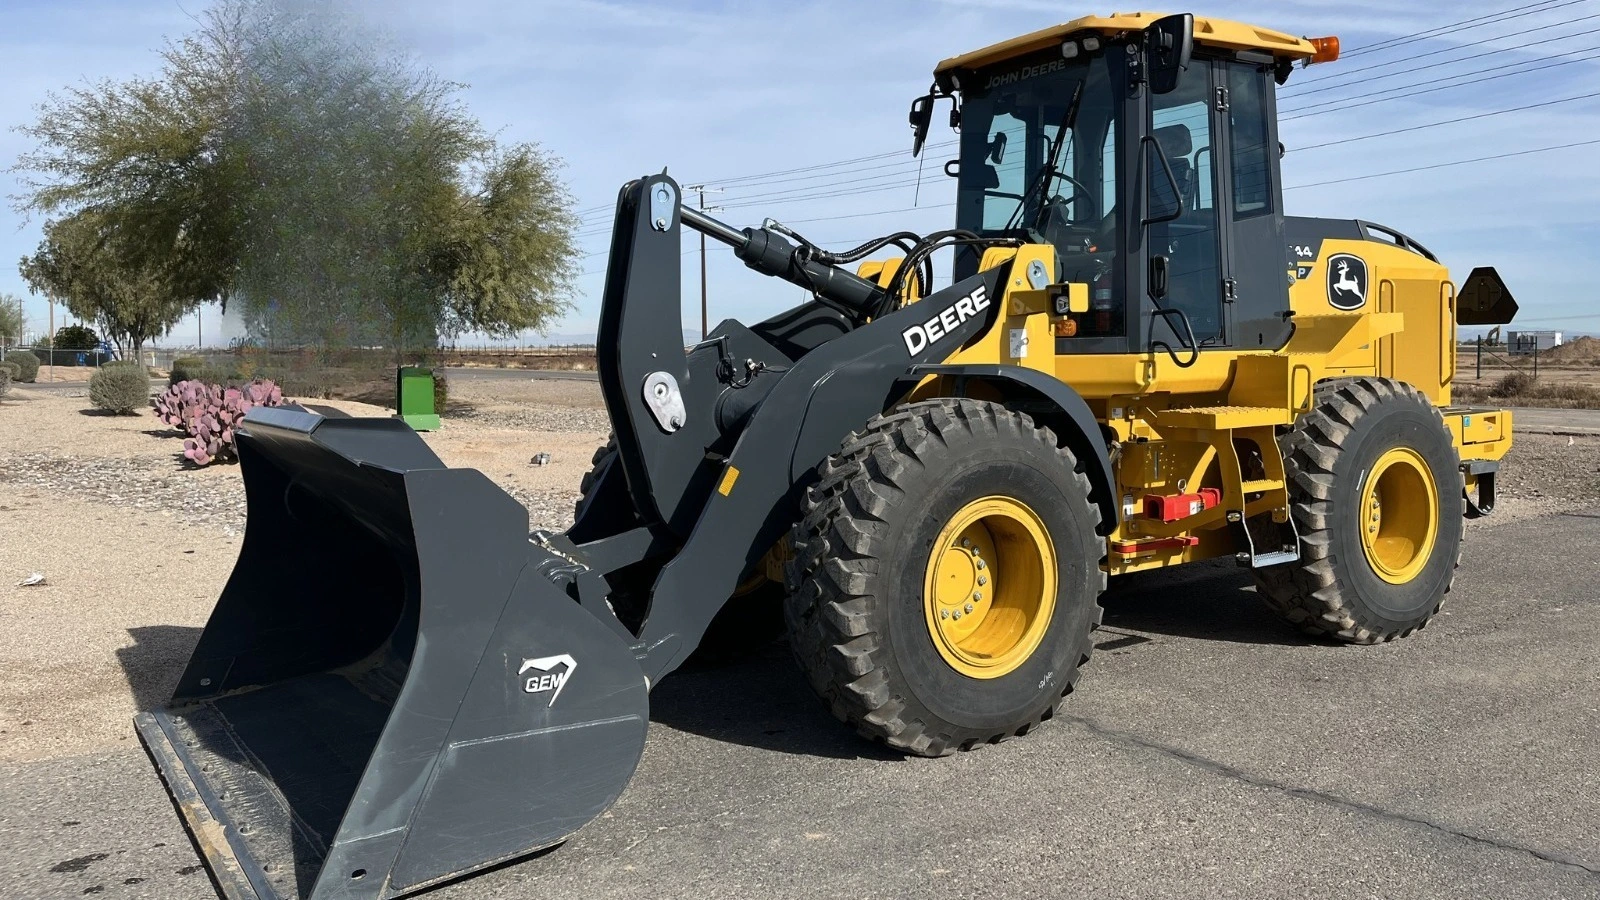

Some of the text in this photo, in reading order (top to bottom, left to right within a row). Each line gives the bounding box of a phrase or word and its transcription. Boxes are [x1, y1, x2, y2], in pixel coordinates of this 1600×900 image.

[984, 59, 1066, 89] JOHN DEERE
[1288, 245, 1313, 257] 44
[902, 285, 991, 357] DEERE
[525, 672, 565, 693] GEM
